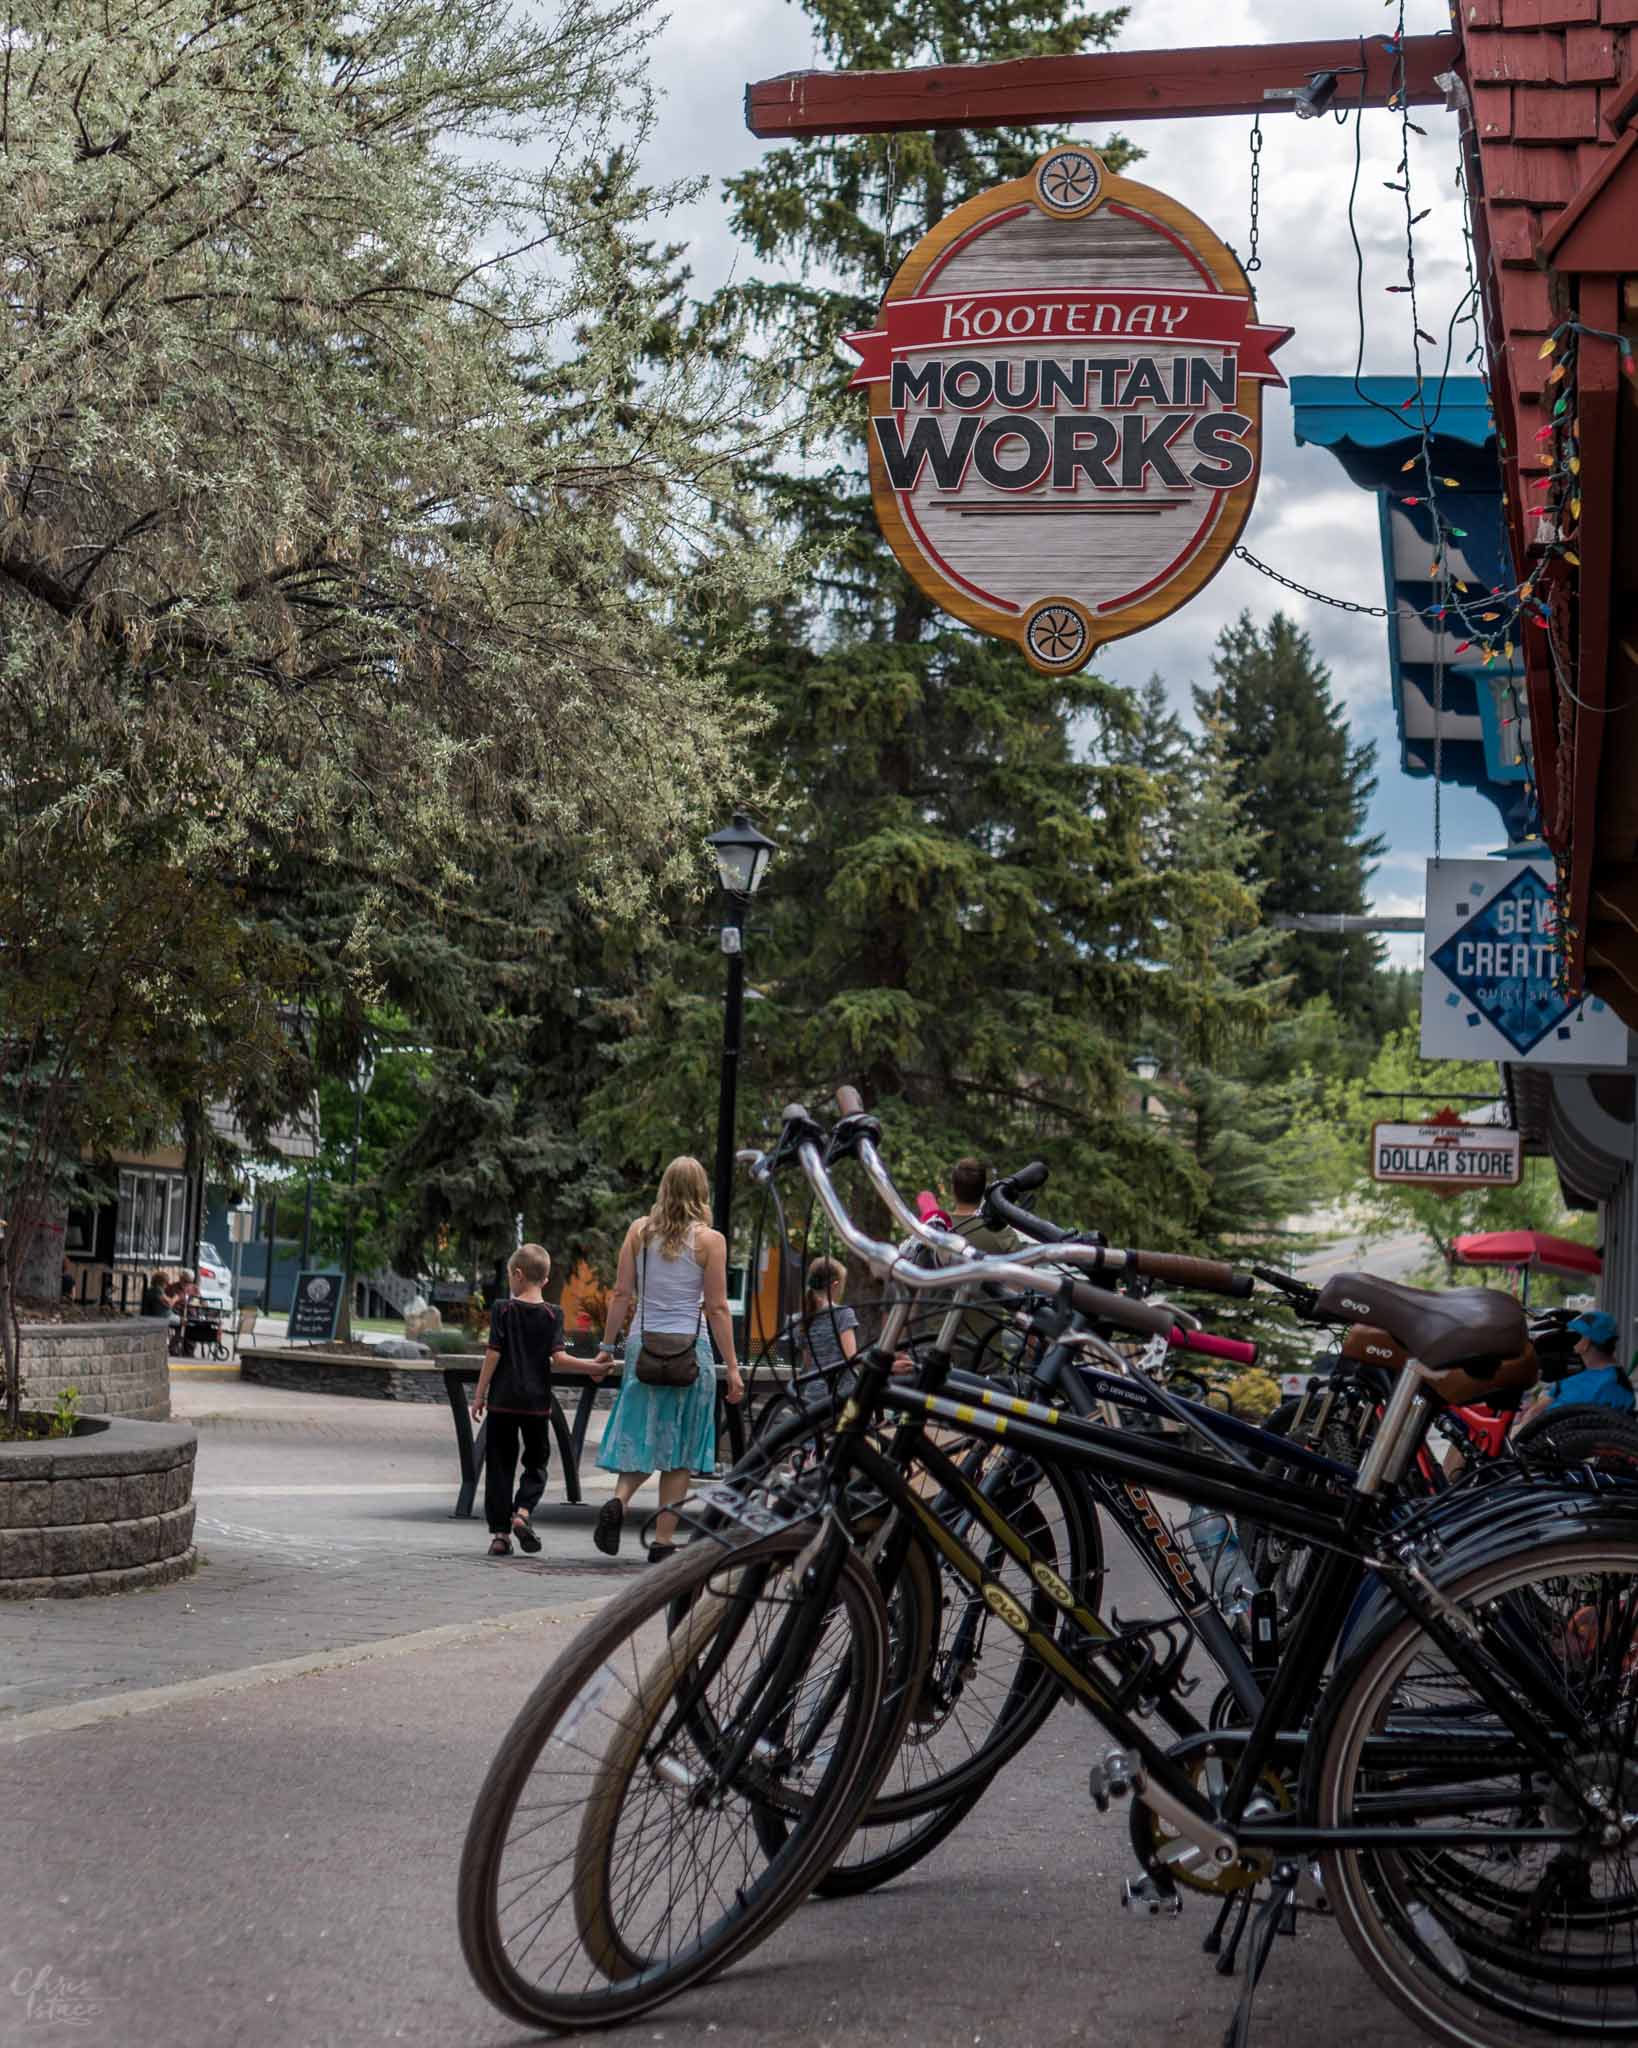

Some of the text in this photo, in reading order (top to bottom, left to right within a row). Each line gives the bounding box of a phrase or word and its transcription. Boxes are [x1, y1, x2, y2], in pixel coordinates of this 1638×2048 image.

[942, 302, 1189, 339] KOOTENAY
[890, 356, 1238, 409] MOUNTAIN
[872, 411, 1254, 491] WORKS
[1379, 1149, 1514, 1174] DOLLAR STORE
[1341, 1298, 1371, 1315] evo
[1366, 1345, 1393, 1359] evo
[1037, 1569, 1069, 1601] evo
[988, 1591, 1023, 1625] evo
